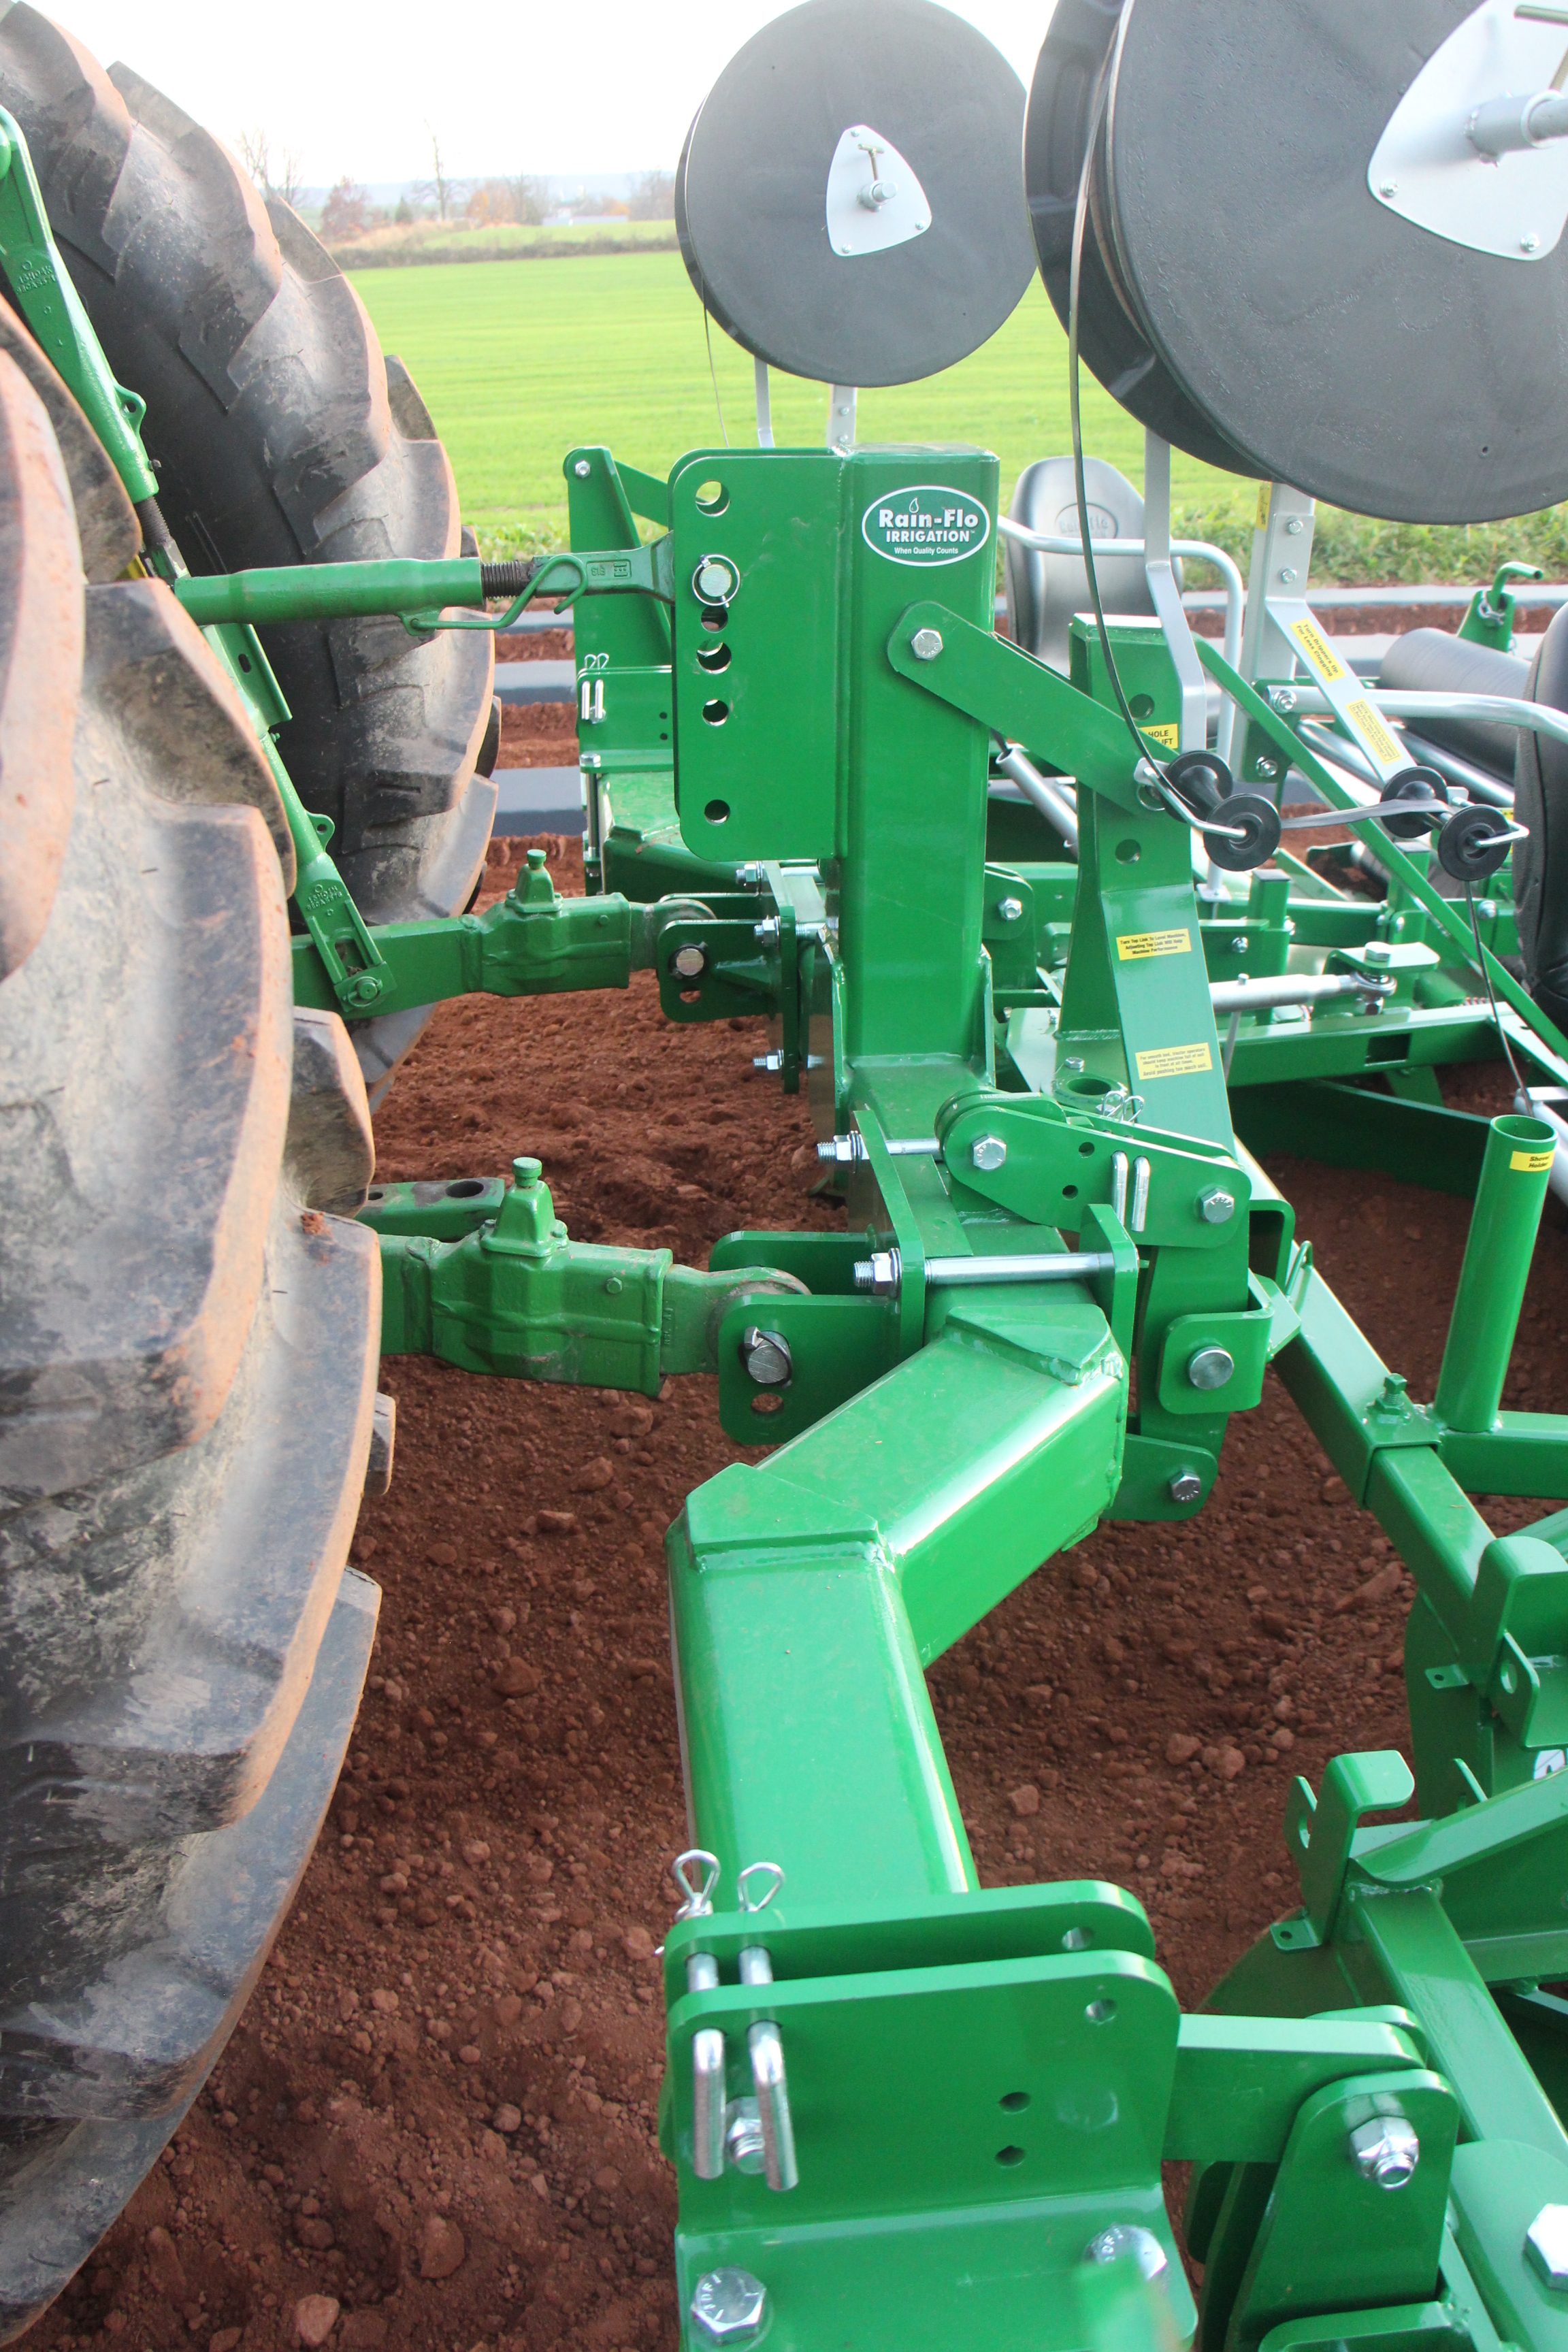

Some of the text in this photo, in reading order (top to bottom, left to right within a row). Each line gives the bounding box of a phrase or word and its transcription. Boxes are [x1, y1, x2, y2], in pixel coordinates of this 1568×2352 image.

[879, 508, 979, 529] Rain-Flo
[885, 530, 970, 542] IRRIGATION
[913, 546, 935, 555] Quality
[1296, 625, 1333, 676] For Less Clogging
[1304, 624, 1339, 673] Turn Drippers Up
